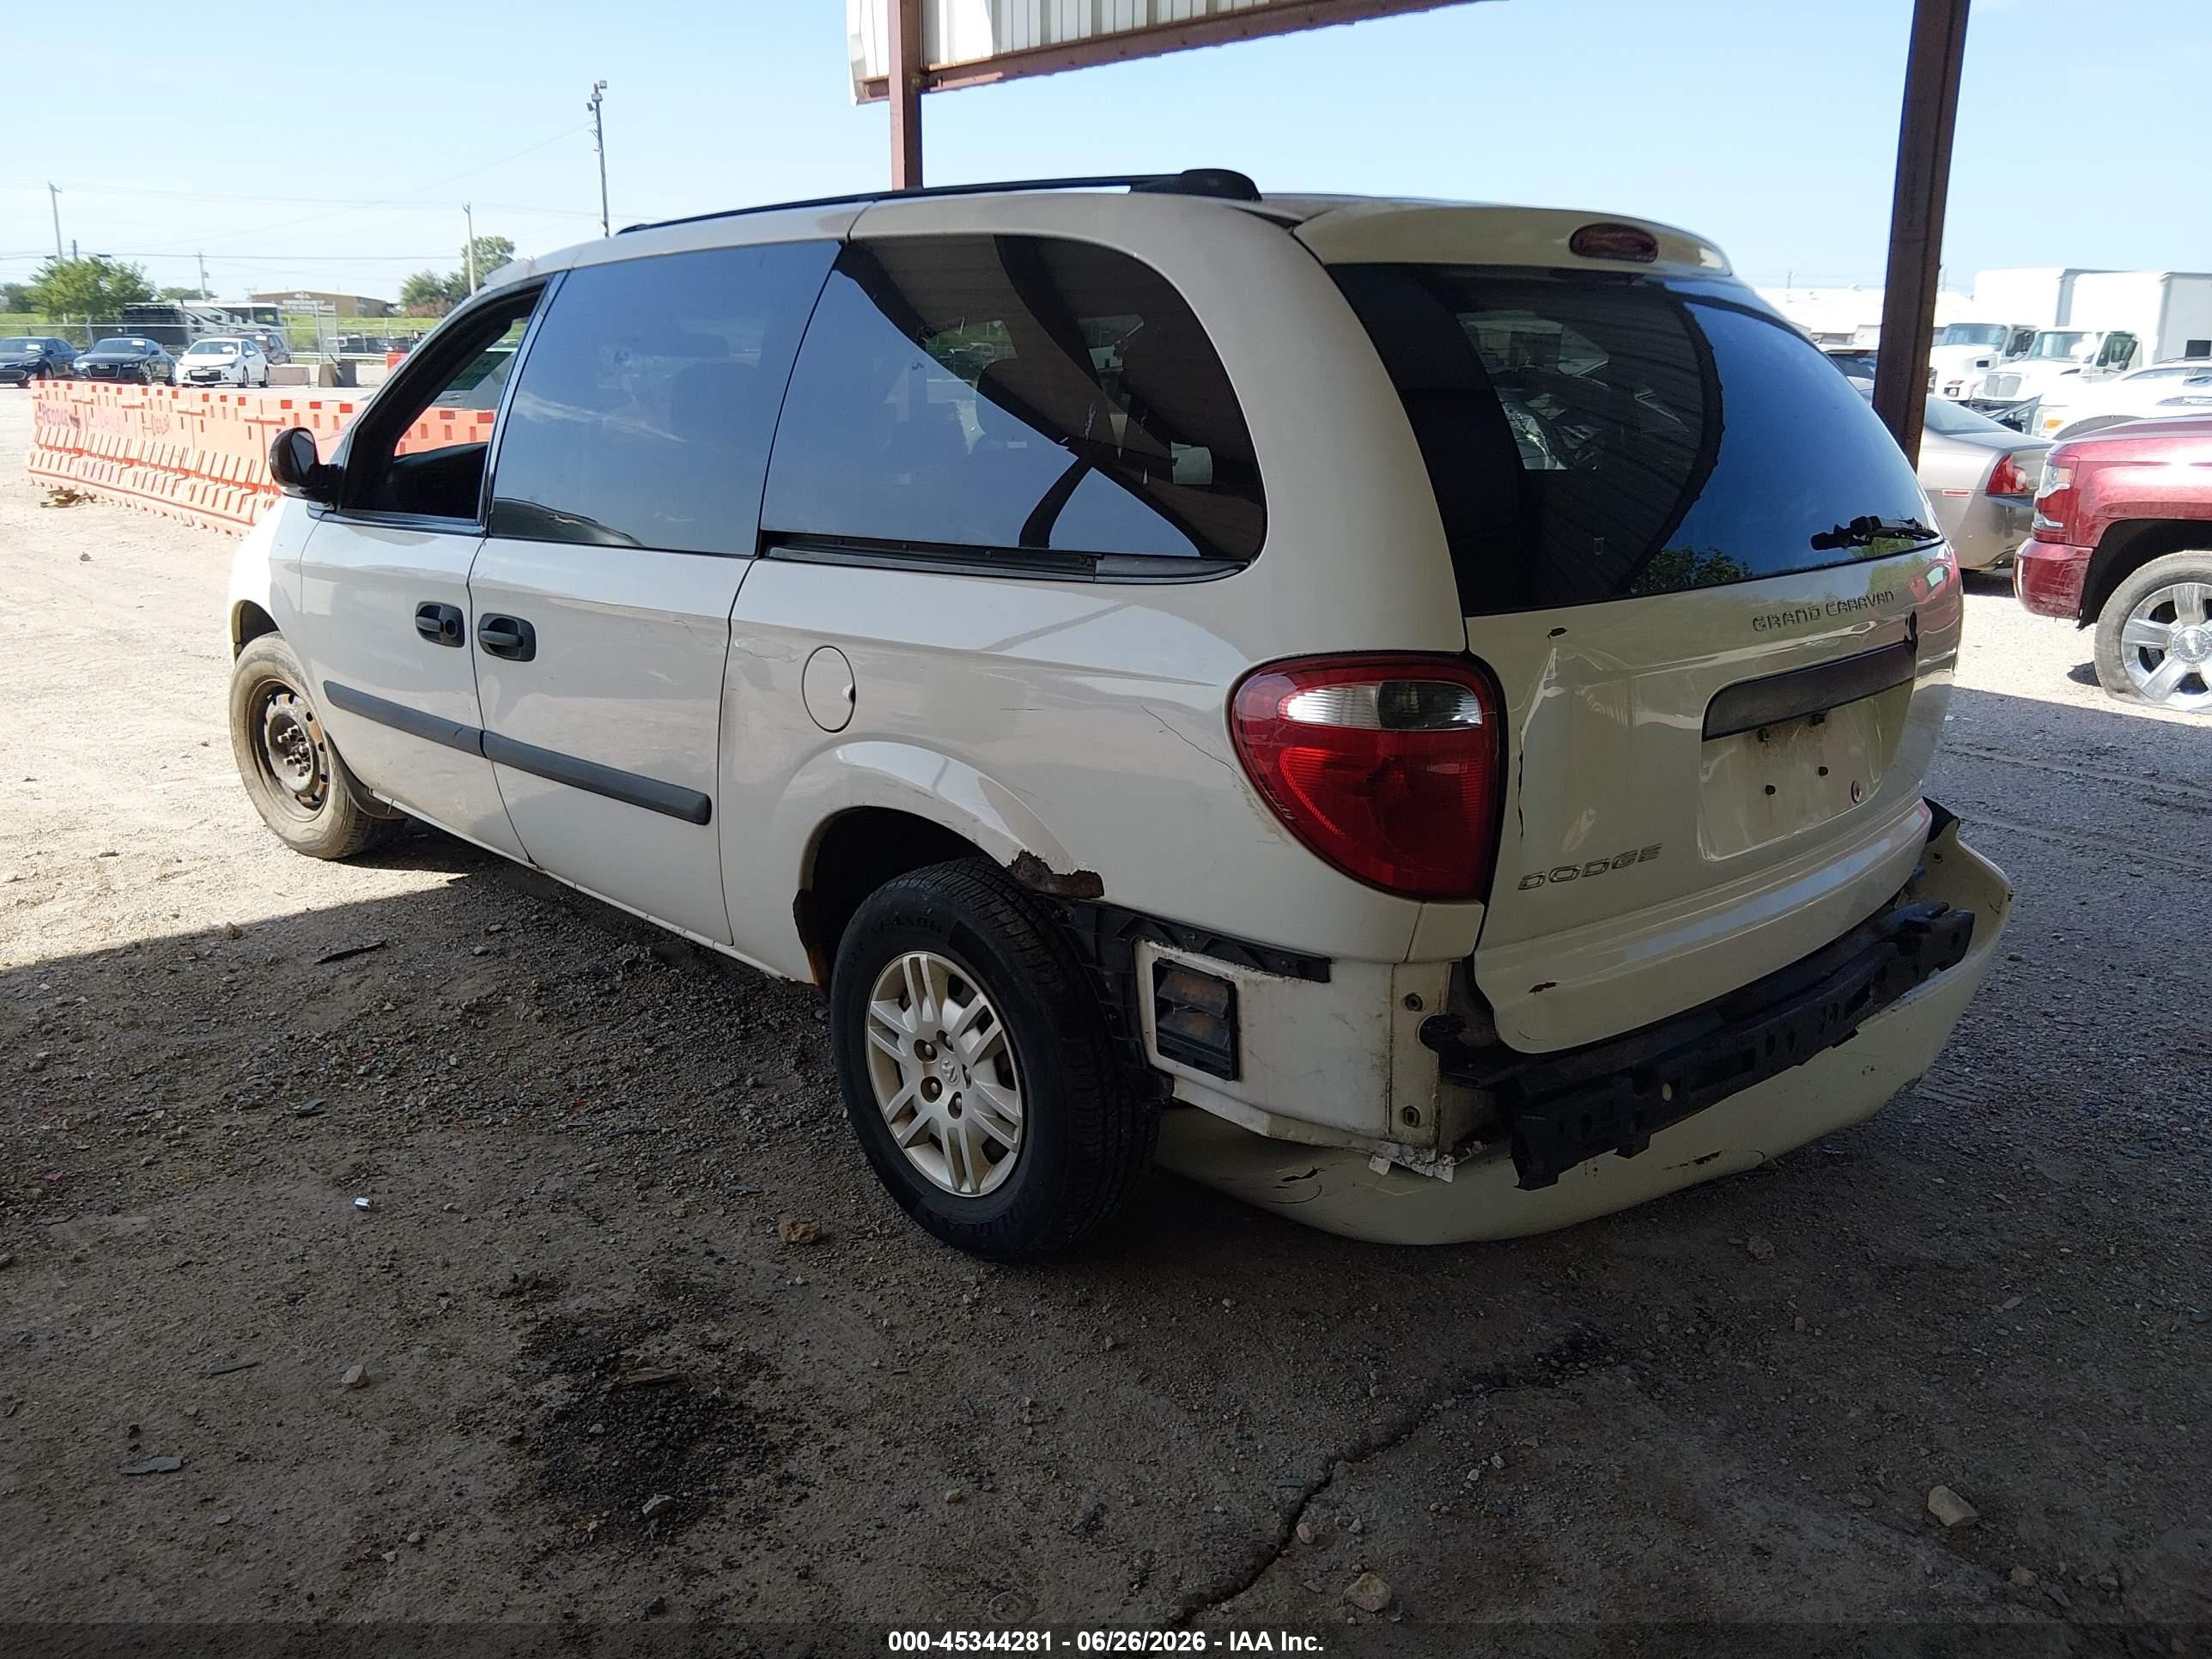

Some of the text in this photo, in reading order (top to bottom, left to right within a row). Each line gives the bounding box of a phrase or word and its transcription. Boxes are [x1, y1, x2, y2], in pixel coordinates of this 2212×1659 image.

[1752, 590, 1895, 632] GRAND CARAVAN
[1517, 843, 1663, 890] DODGE
